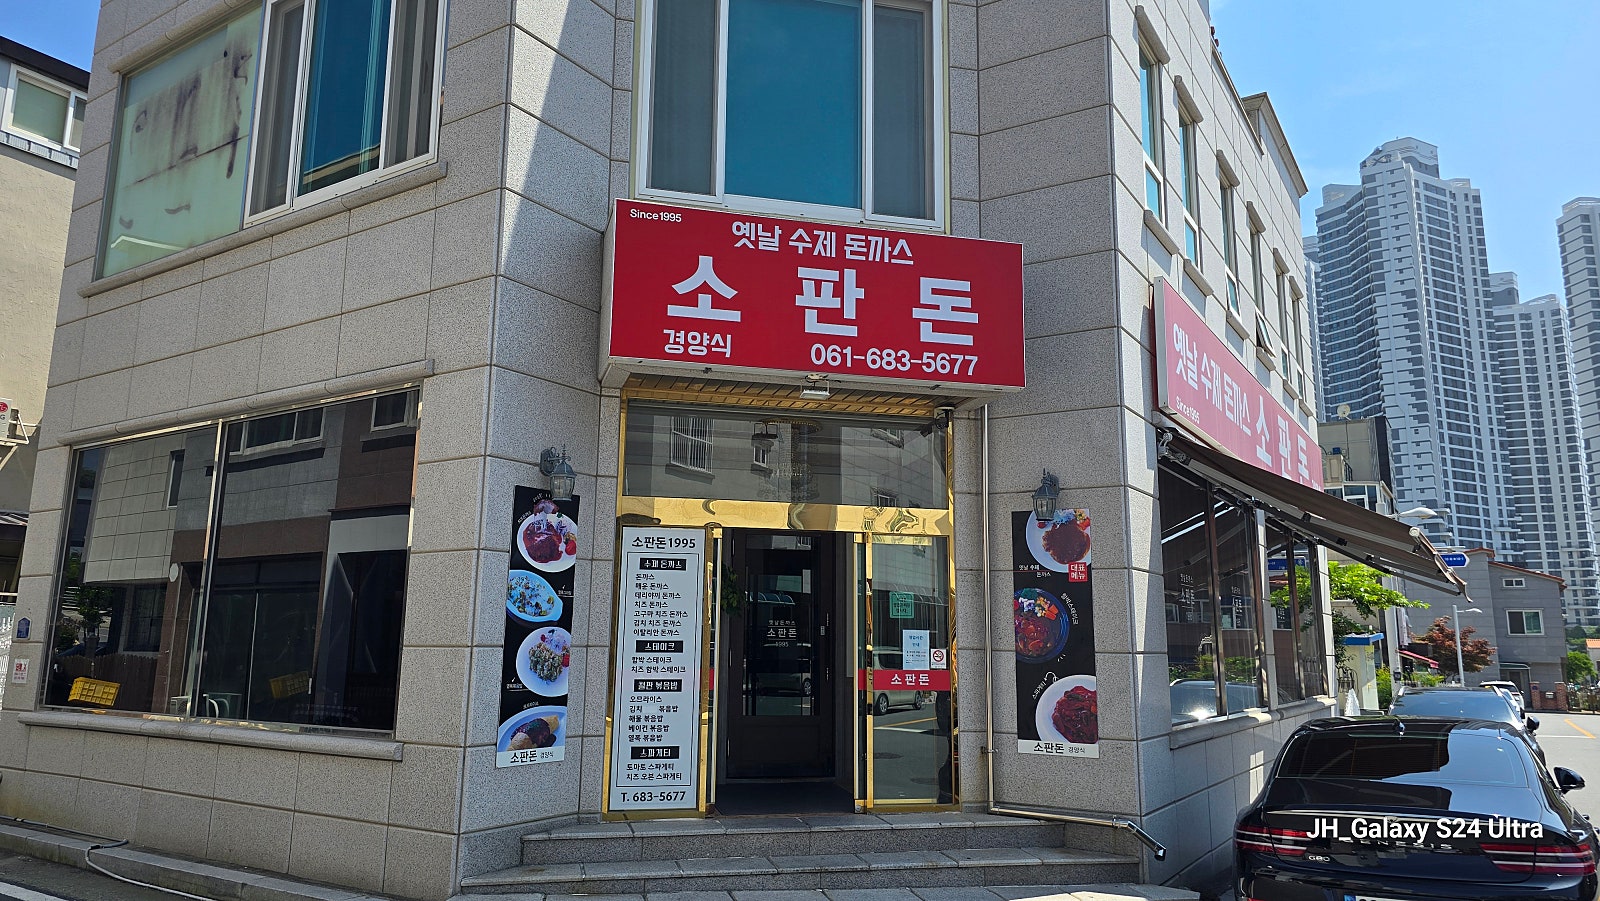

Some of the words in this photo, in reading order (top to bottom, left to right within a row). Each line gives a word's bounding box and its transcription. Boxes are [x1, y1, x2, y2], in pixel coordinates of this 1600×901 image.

[732, 220, 782, 251] 옛날
[788, 228, 836, 258] 수제
[844, 234, 914, 265] 돈까스
[663, 329, 732, 357] 경양식
[810, 343, 978, 376] 061-683-5677
[1173, 323, 1198, 391] 옛날
[1201, 352, 1222, 412] 수제
[1224, 371, 1252, 437] 돈까스
[644, 642, 675, 651] 스테이크
[630, 706, 642, 714] 김치
[640, 748, 671, 758] 스파게티
[1034, 742, 1064, 754] 소판돈
[510, 750, 538, 763] 소판돈
[656, 772, 682, 780] 스파게티
[620, 792, 630, 802] T.
[632, 791, 686, 802] 683-5677
